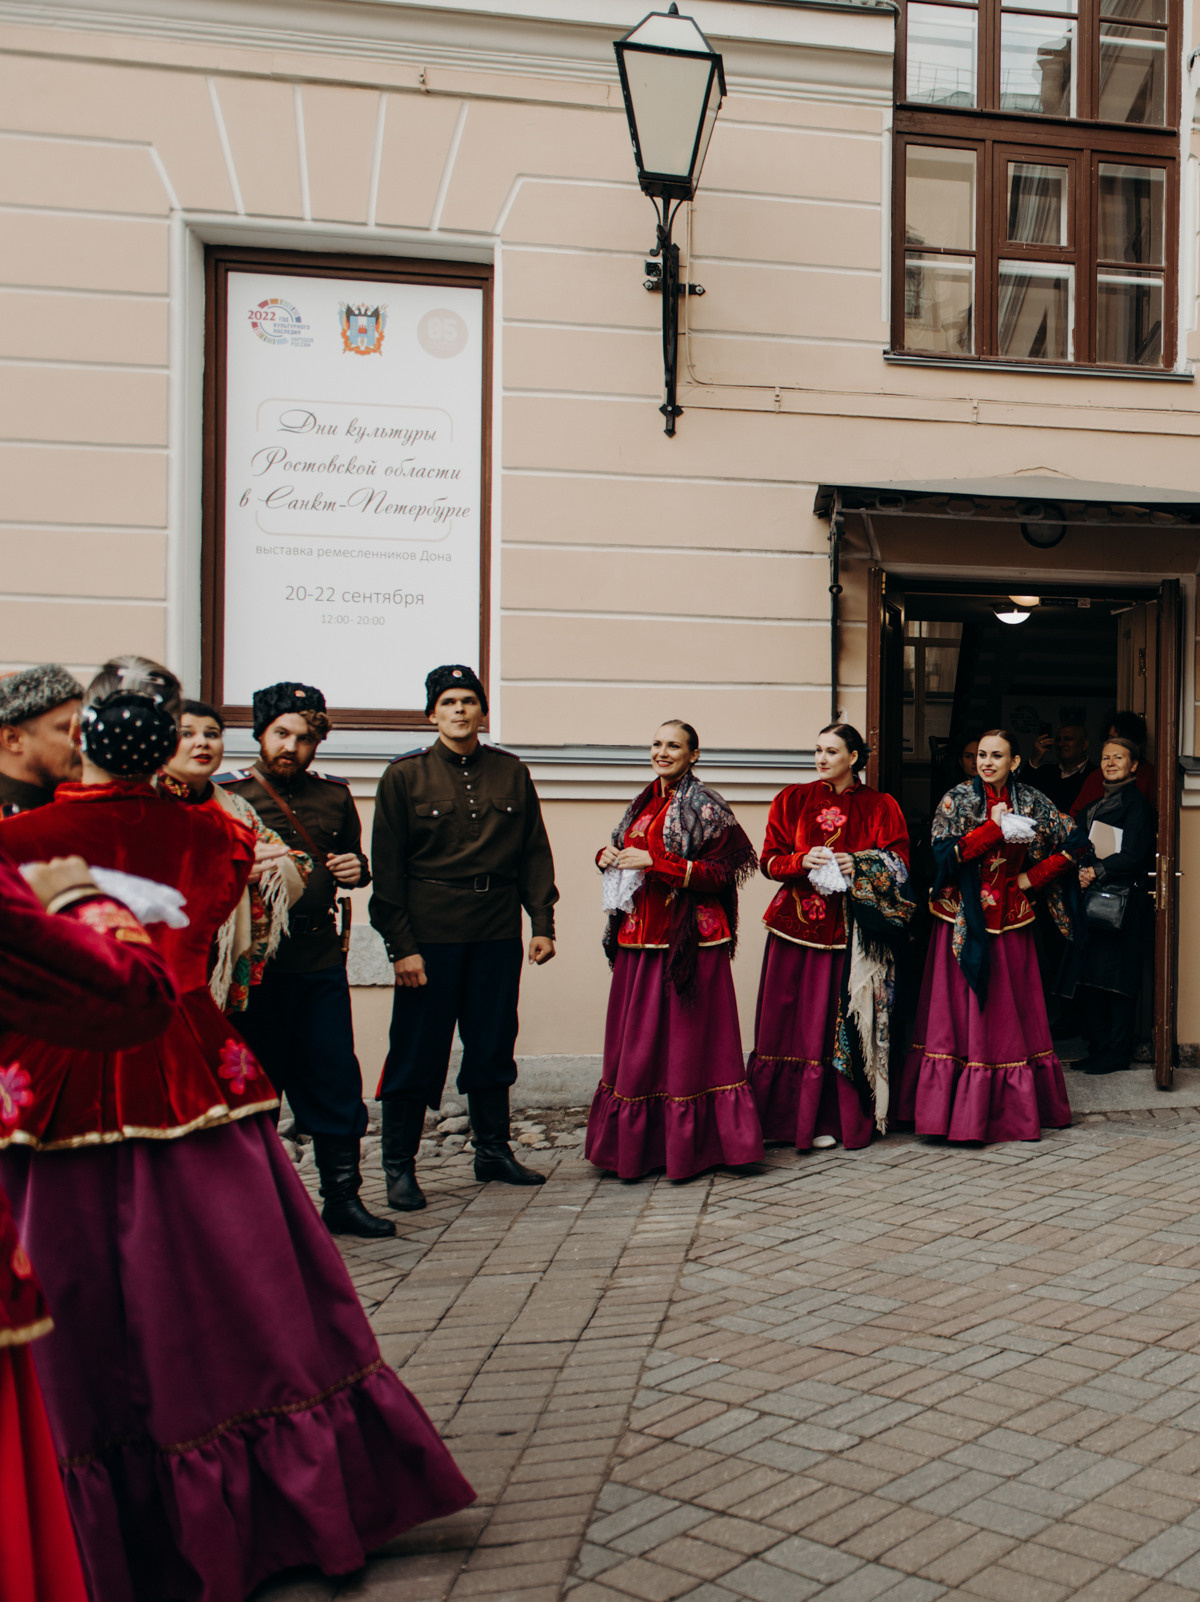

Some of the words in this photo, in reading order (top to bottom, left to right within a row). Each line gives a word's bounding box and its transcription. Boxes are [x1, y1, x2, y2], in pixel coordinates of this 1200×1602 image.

[247, 310, 277, 321] 2022
[276, 408, 338, 436] Дни
[345, 417, 437, 447] культуры
[251, 446, 378, 477] Ростовской
[384, 457, 462, 480] области
[238, 488, 252, 508] в
[257, 485, 471, 524] Санкт-Петербурге
[255, 545, 314, 557] выставка
[317, 548, 417, 561] ремесленников
[419, 550, 452, 563] Дона
[285, 585, 336, 602] 20-22
[341, 589, 425, 608] сентября
[356, 615, 386, 626] 20:00
